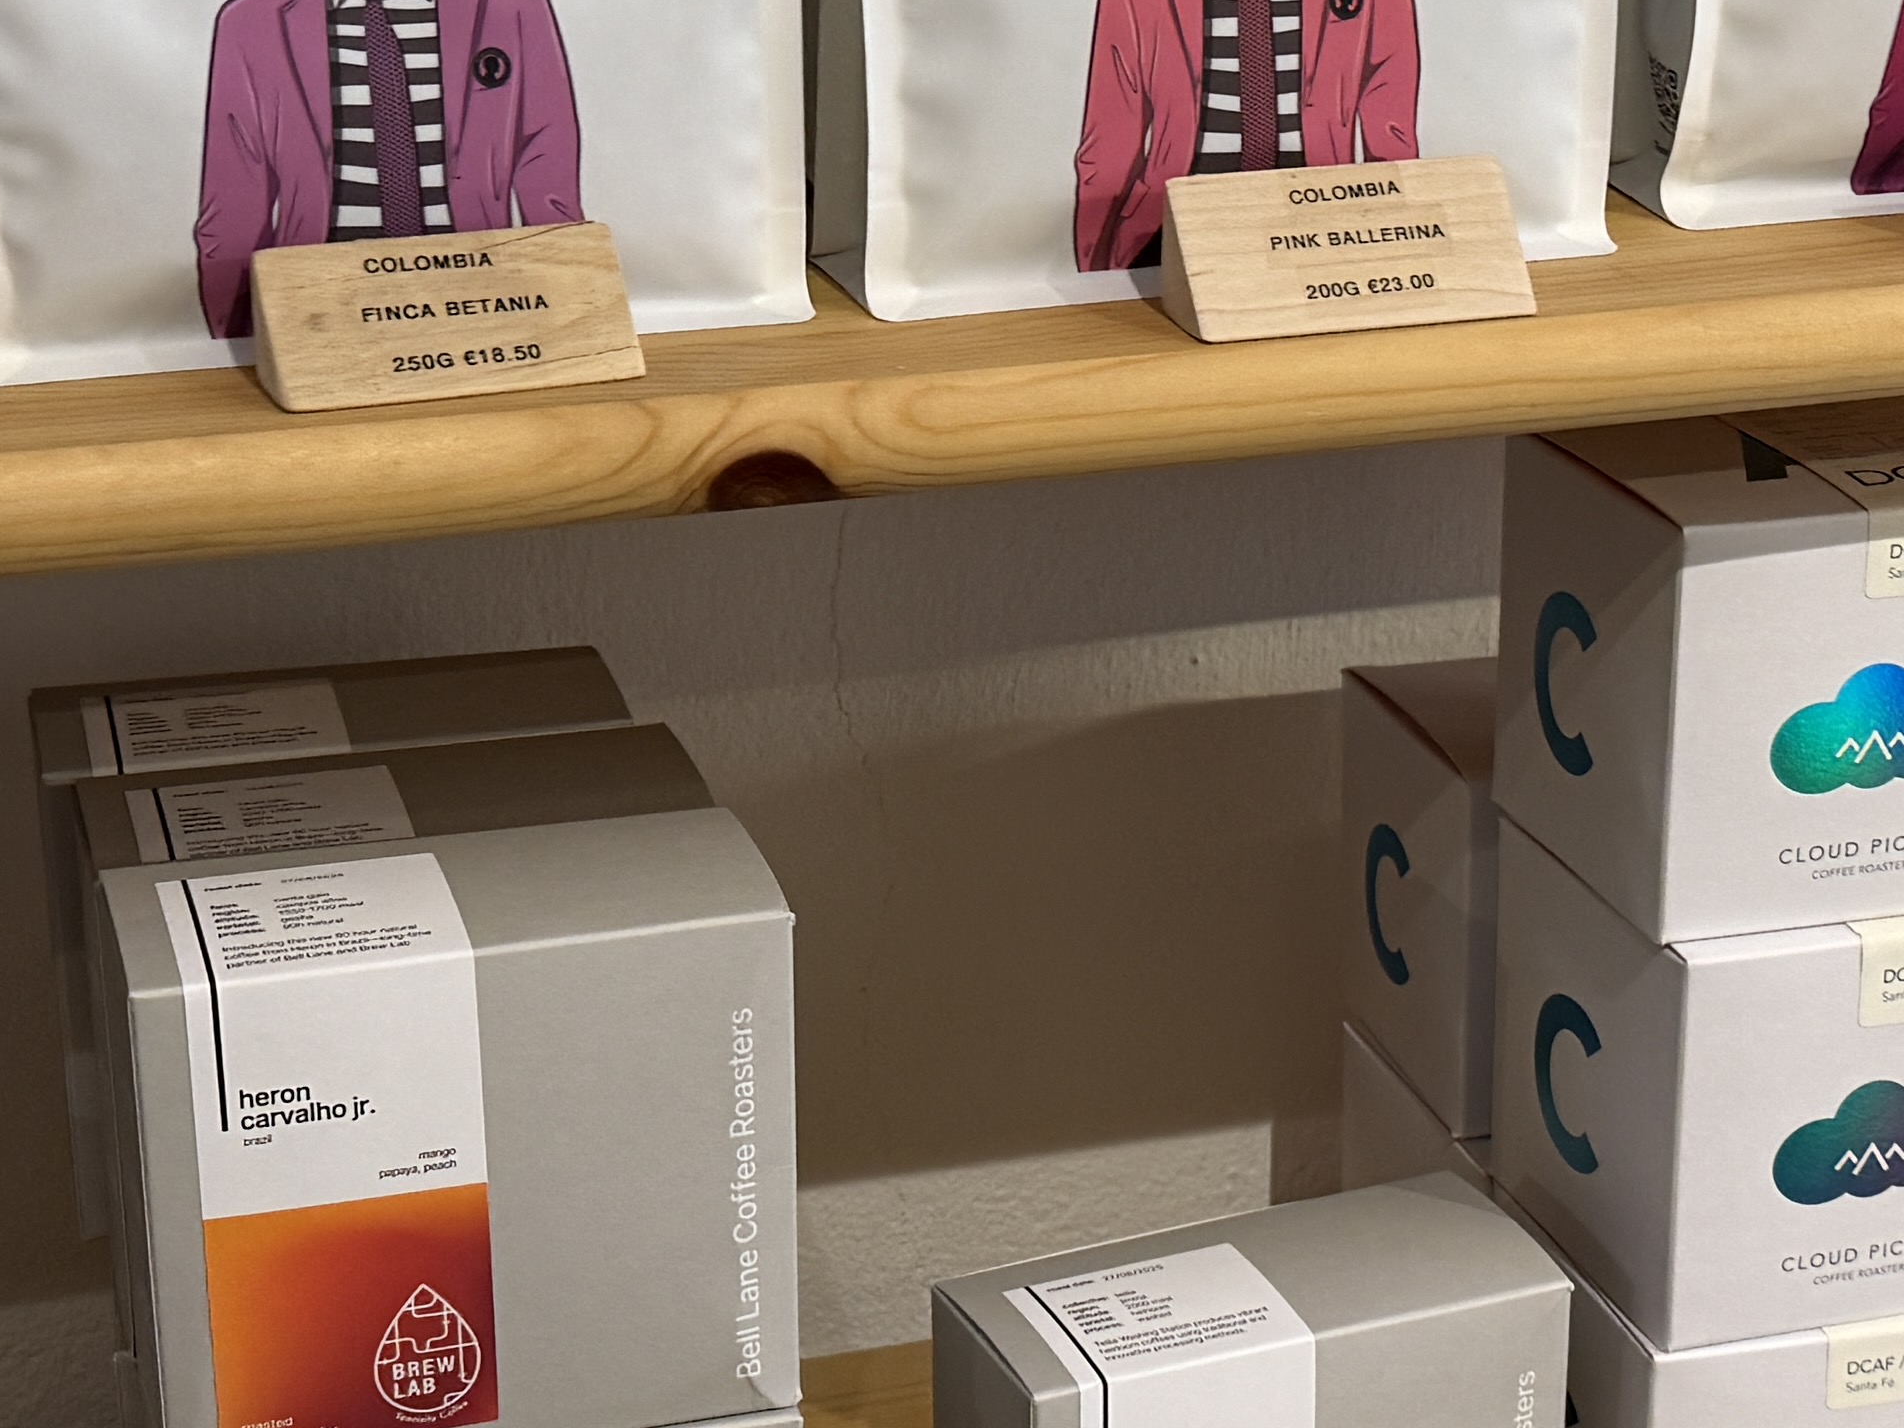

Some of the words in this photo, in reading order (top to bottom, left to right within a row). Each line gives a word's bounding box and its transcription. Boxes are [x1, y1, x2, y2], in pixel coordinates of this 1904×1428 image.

[1289, 180, 1400, 204] COLOMBIA
[1270, 233, 1320, 251] PINK
[1329, 224, 1445, 246] BALLERINA
[363, 253, 493, 274] COLOMBIA
[1306, 282, 1360, 299] 200G
[1367, 273, 1434, 294] €23.00
[361, 301, 436, 322] FINCA
[446, 294, 549, 316] BETANIA
[393, 352, 455, 372] 250G
[465, 344, 542, 366] €18.50
[1778, 841, 1859, 864] CLOUD
[1812, 866, 1855, 880] COFFEE
[729, 1007, 756, 1139] Roasters
[239, 1086, 311, 1109] heron
[241, 1102, 346, 1130] carvalho
[352, 1096, 376, 1121] jr.
[418, 1147, 456, 1161] mango
[379, 1164, 421, 1180] papaya,
[423, 1158, 457, 1174] peach
[731, 1143, 757, 1244] Coffee
[1781, 1248, 1858, 1272] CLOUD
[736, 1249, 760, 1324] Lane
[1813, 1271, 1854, 1285] COFFEE
[736, 1325, 762, 1380] Bell
[392, 1355, 455, 1380] BREW
[1847, 1356, 1895, 1375] DCAF
[393, 1377, 436, 1399] LAB
[1846, 1380, 1877, 1393] Santa
